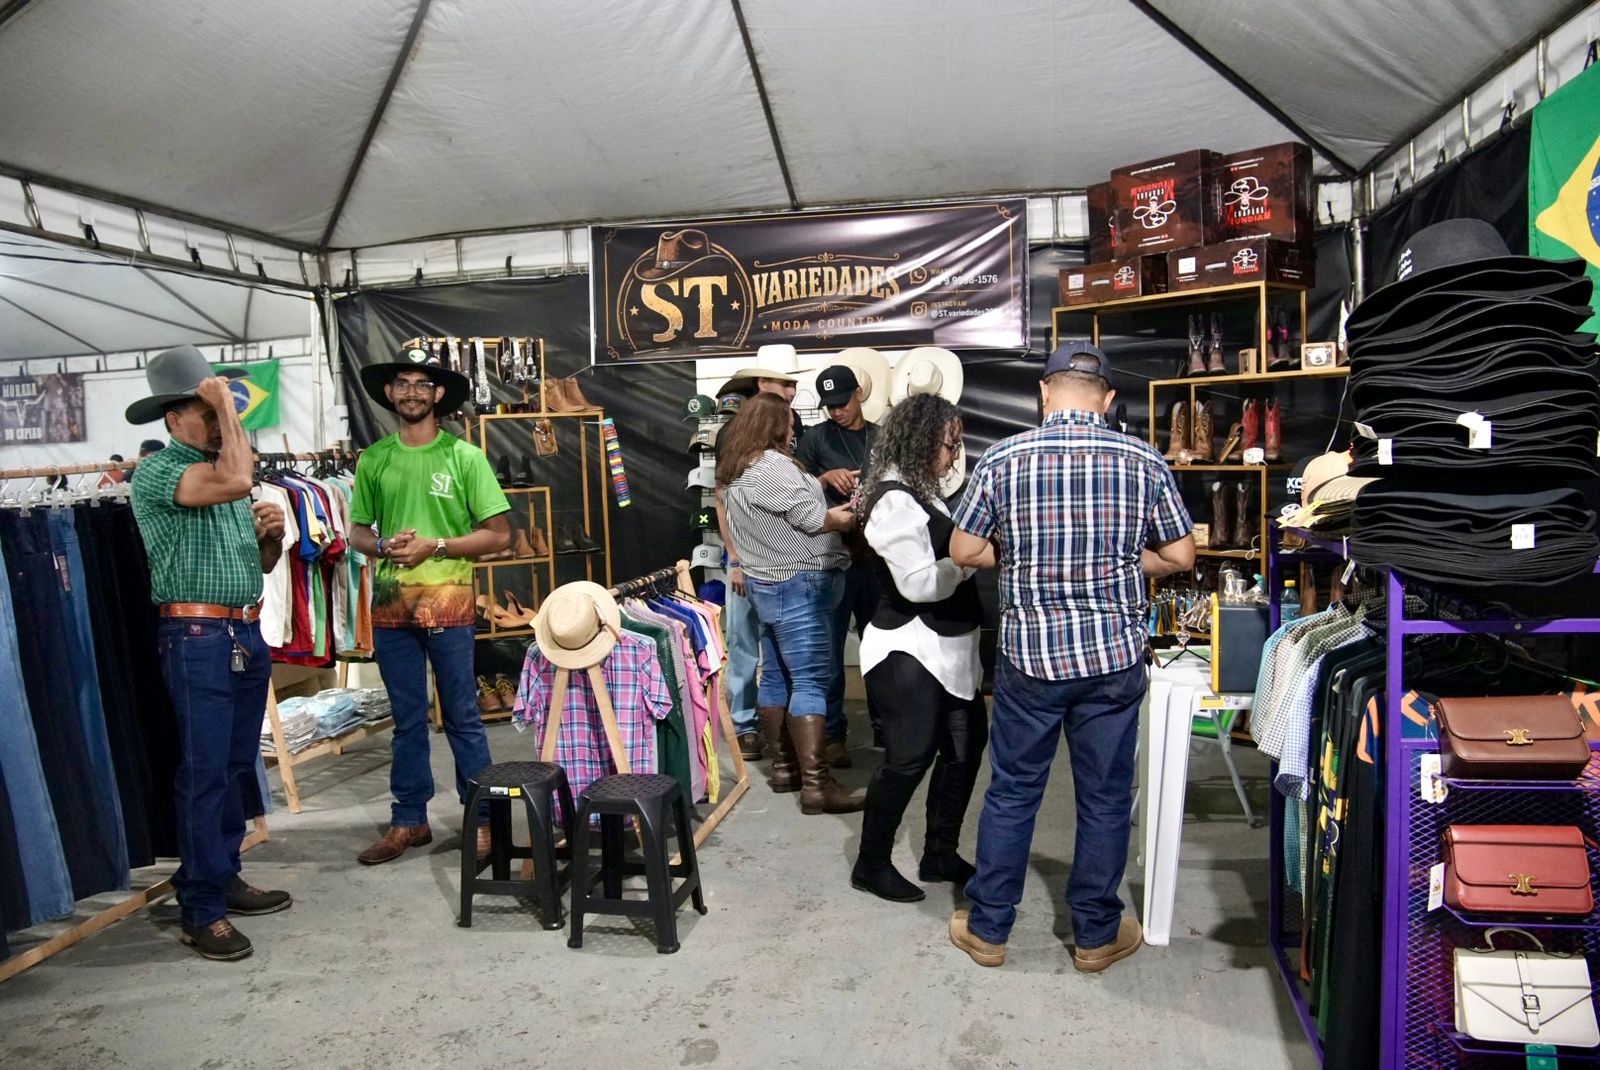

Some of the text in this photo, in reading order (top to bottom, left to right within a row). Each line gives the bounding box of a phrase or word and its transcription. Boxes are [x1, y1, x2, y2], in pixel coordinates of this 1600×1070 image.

[752, 265, 900, 308] VARIEDADES
[641, 275, 728, 342] ST
[771, 316, 884, 331] MODA COUNTRY
[431, 472, 452, 493] ST
